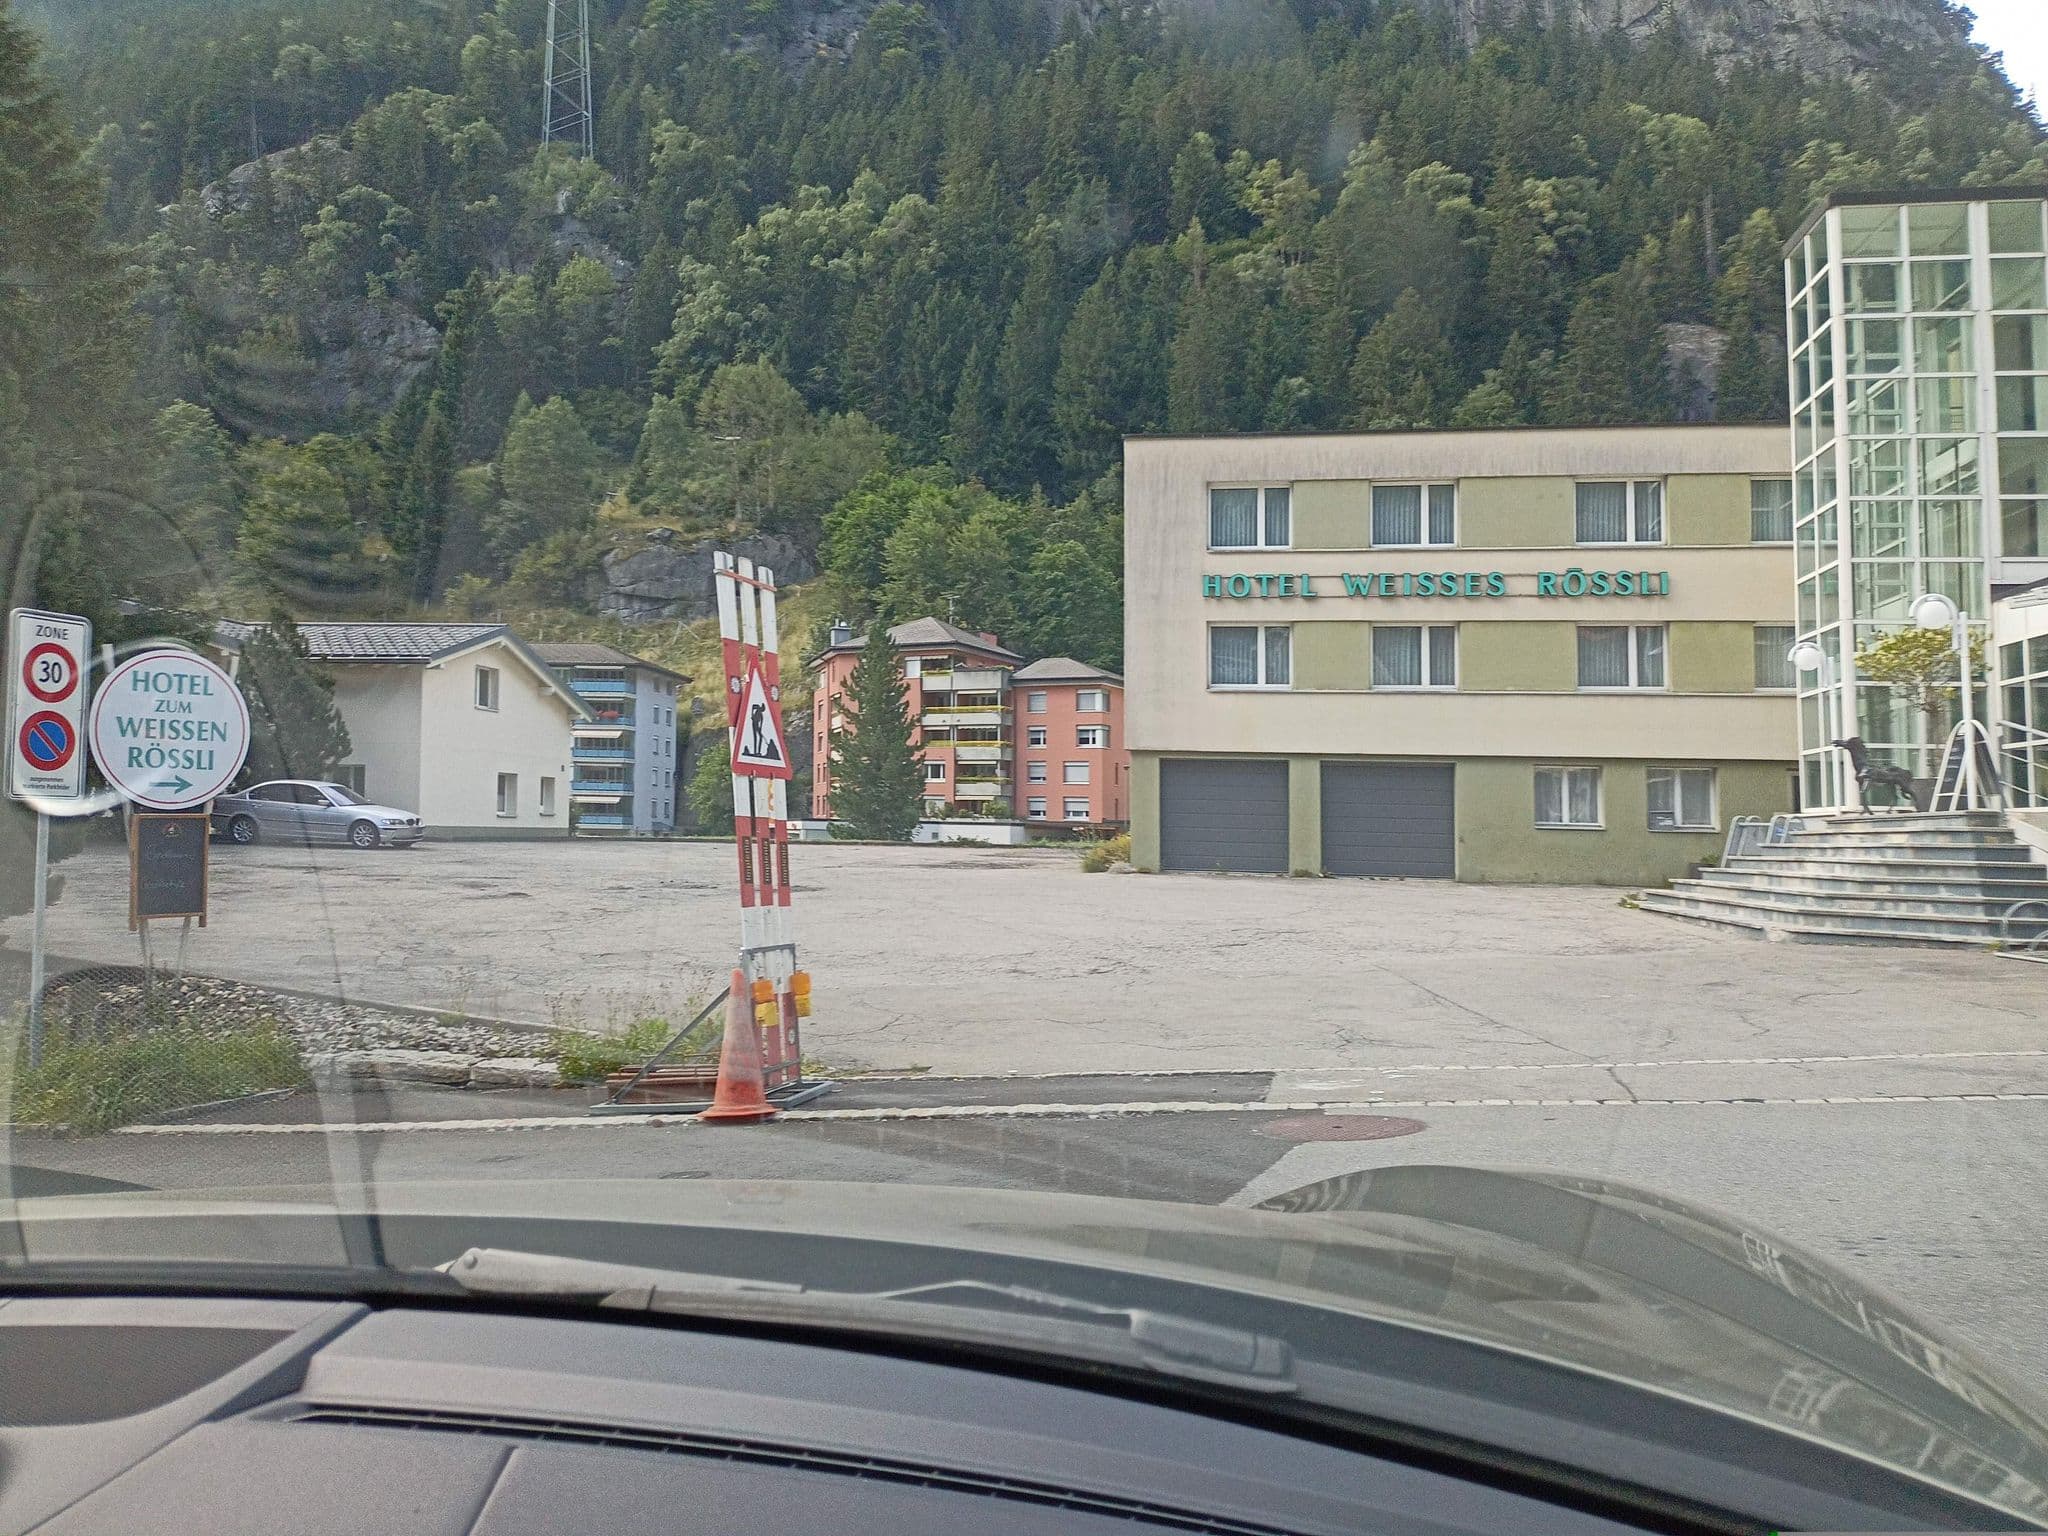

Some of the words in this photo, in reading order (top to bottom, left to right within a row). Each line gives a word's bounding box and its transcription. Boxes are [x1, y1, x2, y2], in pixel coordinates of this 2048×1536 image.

[1201, 573, 1319, 599] HOTEL
[1341, 572, 1506, 598] WEISSES
[1537, 567, 1670, 597] RÖSSLI
[35, 625, 69, 641] ZONE
[38, 660, 62, 684] 30
[132, 670, 214, 697] HOTEL
[154, 700, 192, 714] ZUM
[116, 716, 228, 742] WEISSEN
[127, 743, 214, 771] RÖSSLI
